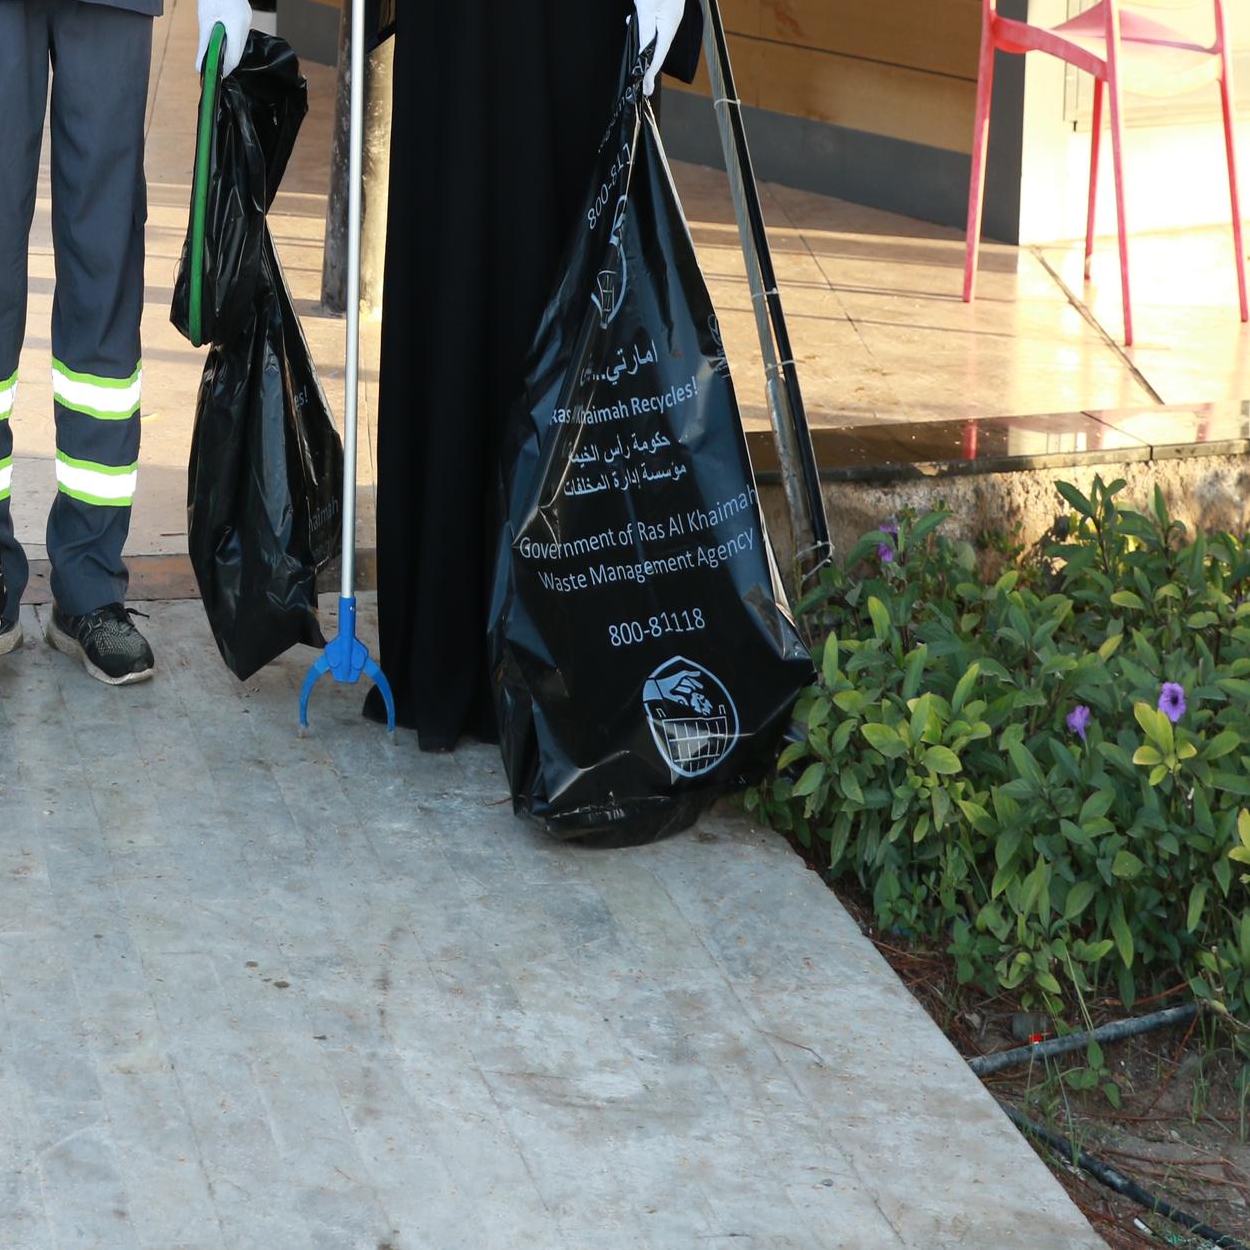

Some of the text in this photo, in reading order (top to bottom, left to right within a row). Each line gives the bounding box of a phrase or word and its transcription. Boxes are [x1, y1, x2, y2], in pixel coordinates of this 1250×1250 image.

[630, 376, 698, 415] Recycles!
[604, 434, 630, 463] رأس
[633, 431, 670, 453] حكومة
[564, 461, 687, 496] مؤسسة إدارة المخلفات
[519, 484, 758, 560] Government of Ras Al Khaimah
[538, 527, 754, 592] Waste Management Agency
[608, 608, 706, 647] 800-81118
